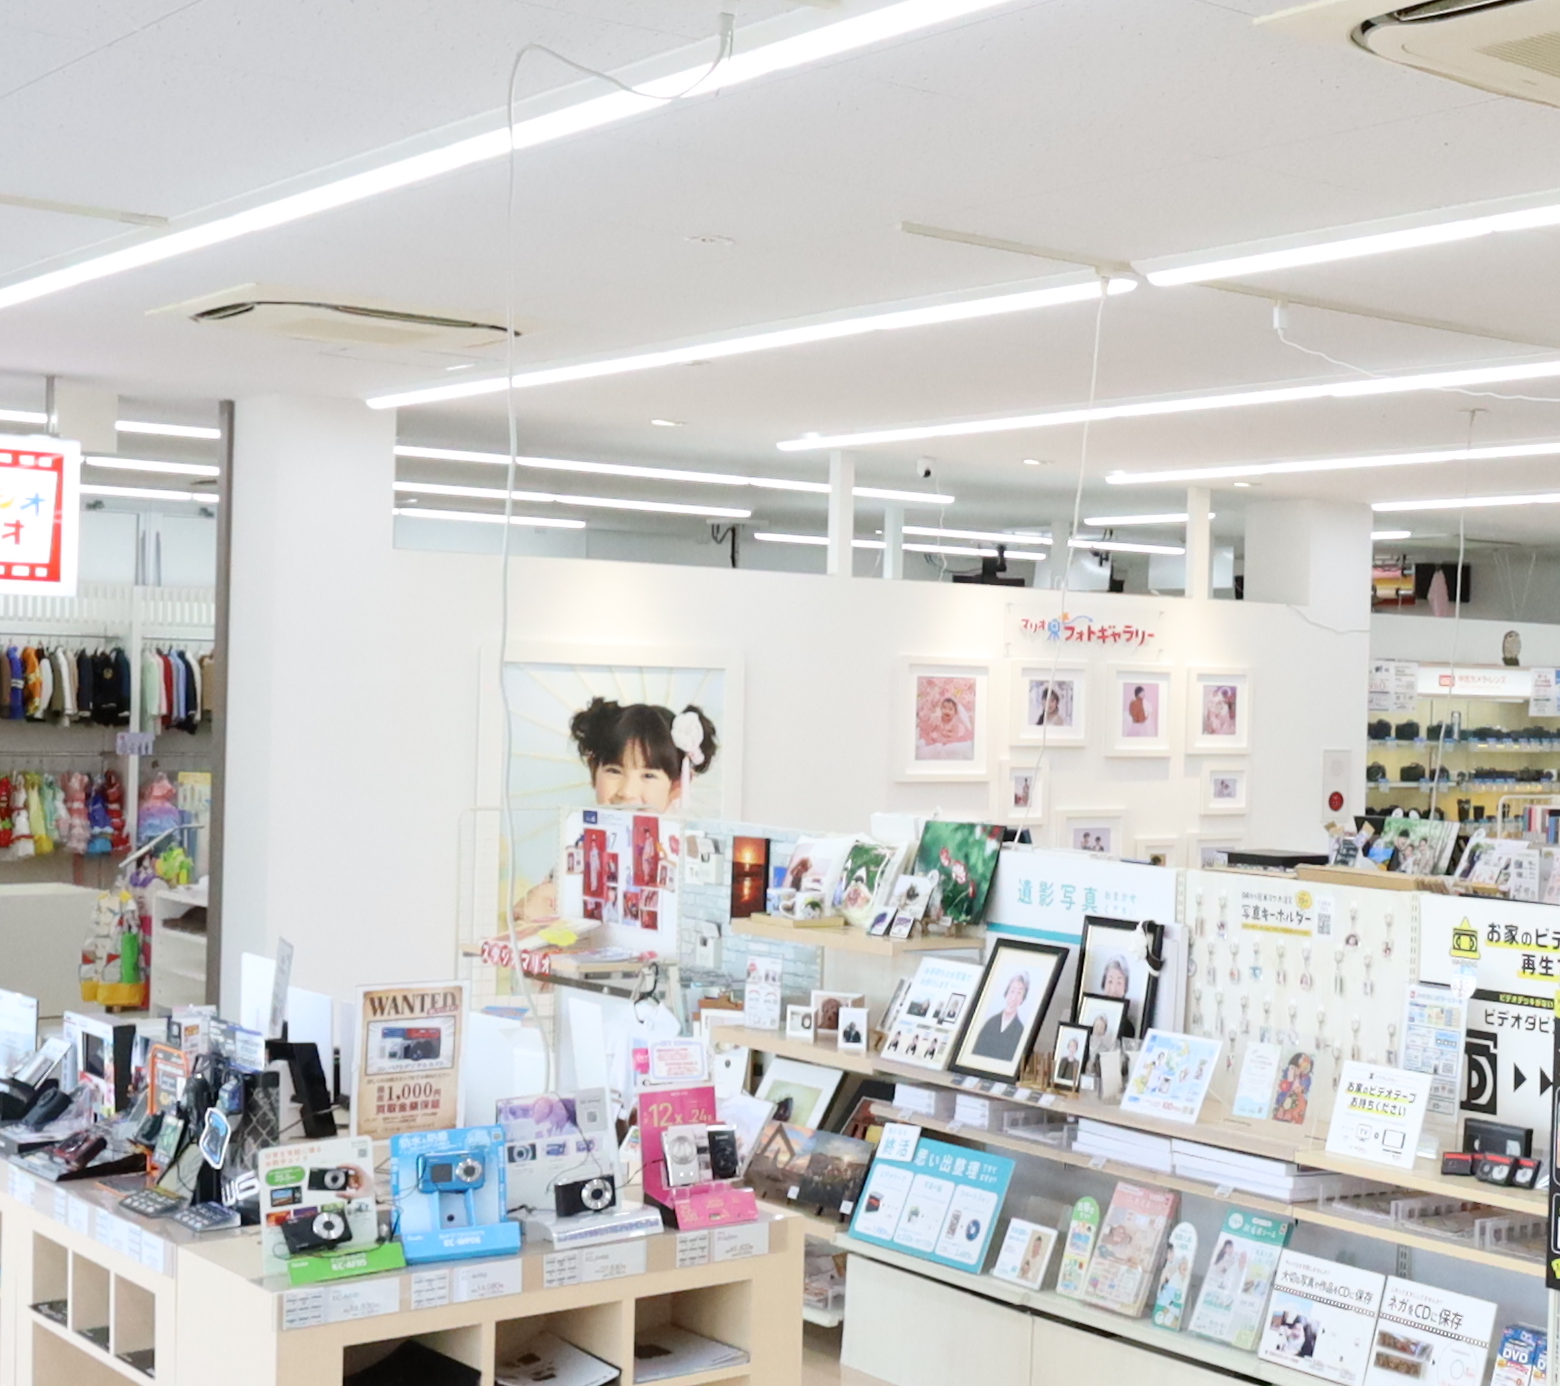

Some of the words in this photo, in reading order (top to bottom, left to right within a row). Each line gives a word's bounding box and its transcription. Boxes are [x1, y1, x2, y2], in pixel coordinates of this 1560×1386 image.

[1064, 624, 1155, 647] フォトギャラリー
[1017, 878, 1099, 914] 遺影写真
[1241, 903, 1312, 926] 写真キーホルダー
[481, 941, 551, 976] スタジマリオ
[369, 991, 459, 1017] WANTED
[1484, 1008, 1555, 1036] ビデオダビ
[386, 1081, 441, 1102] 1,000円
[1346, 1080, 1417, 1104] お家のビデオテープ
[1350, 1099, 1407, 1117] お持ちください
[912, 1147, 982, 1181] 思い出整理
[1388, 1295, 1464, 1330] ネガをCDに保存
[1502, 1346, 1529, 1365] DVD
